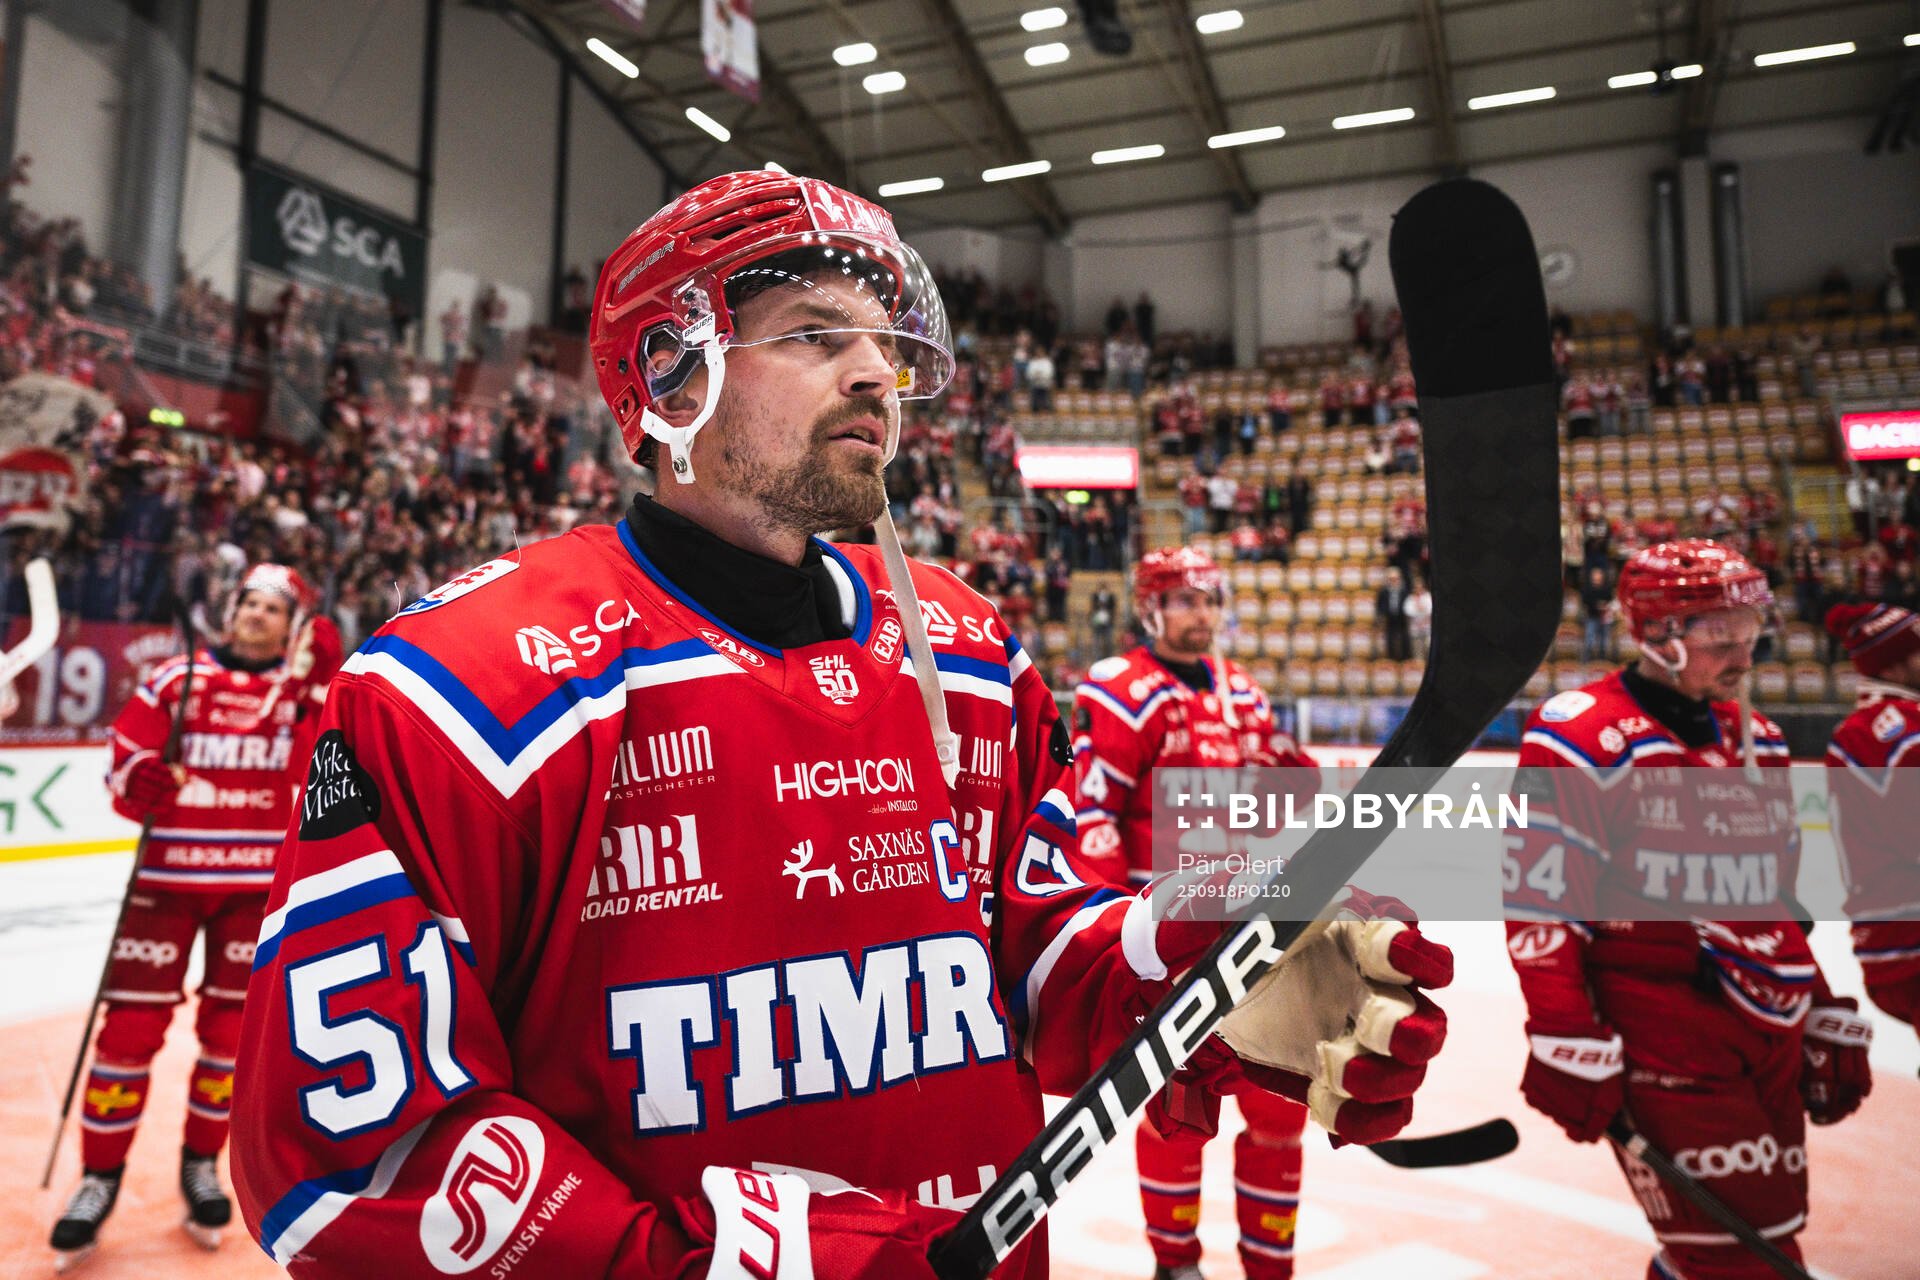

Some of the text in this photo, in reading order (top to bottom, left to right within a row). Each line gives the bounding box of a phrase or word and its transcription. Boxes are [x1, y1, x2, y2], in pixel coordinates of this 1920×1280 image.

[332, 217, 405, 278] SCA
[617, 240, 676, 293] BAUER
[684, 315, 713, 337] BAUER
[873, 620, 901, 661] EAB
[962, 615, 1004, 647] SC
[809, 654, 851, 670] SHL
[812, 669, 860, 697] 50
[34, 645, 106, 727] 19
[183, 725, 293, 770] IMRÅ
[612, 775, 716, 800] ASTIGHETER
[773, 758, 915, 802] HIGHCON
[848, 828, 925, 862] SAXNÄS
[929, 819, 970, 904] C
[634, 882, 723, 914] RENTAL
[852, 861, 930, 893] GÅRDEN
[284, 932, 479, 1142] 51
[605, 930, 1016, 1139] TIMR
[1674, 1133, 1778, 1177] coop
[490, 1171, 582, 1280] SVENSK VÄRME
